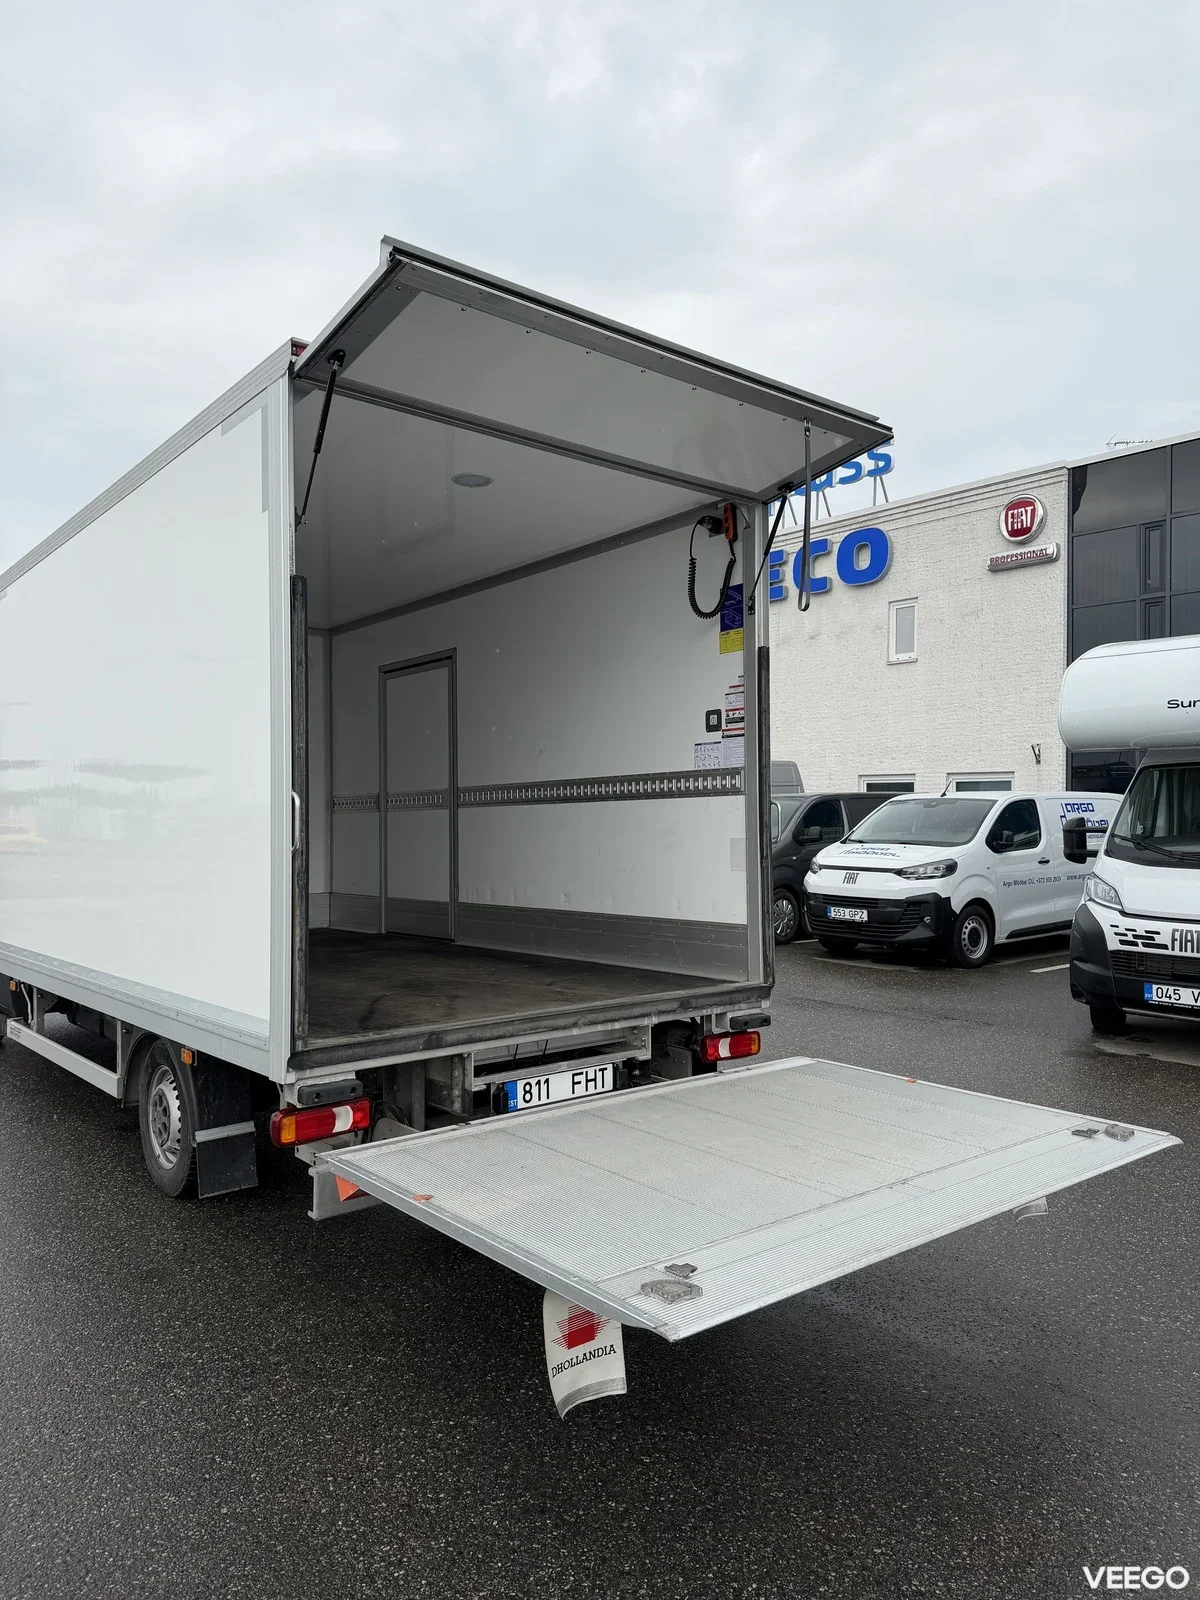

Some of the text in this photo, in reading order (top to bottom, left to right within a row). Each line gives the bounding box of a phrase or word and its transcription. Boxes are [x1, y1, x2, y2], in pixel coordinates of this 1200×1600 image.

[1007, 505, 1034, 531] FIAT
[989, 547, 1048, 566] PROFESSIONAL
[843, 872, 860, 885] FIAT
[833, 908, 846, 918] 553
[848, 910, 865, 920] GPZ
[1156, 986, 1181, 1001] 045
[522, 1067, 608, 1104] 811 FHT
[551, 1344, 617, 1378] DHOLLANDIA
